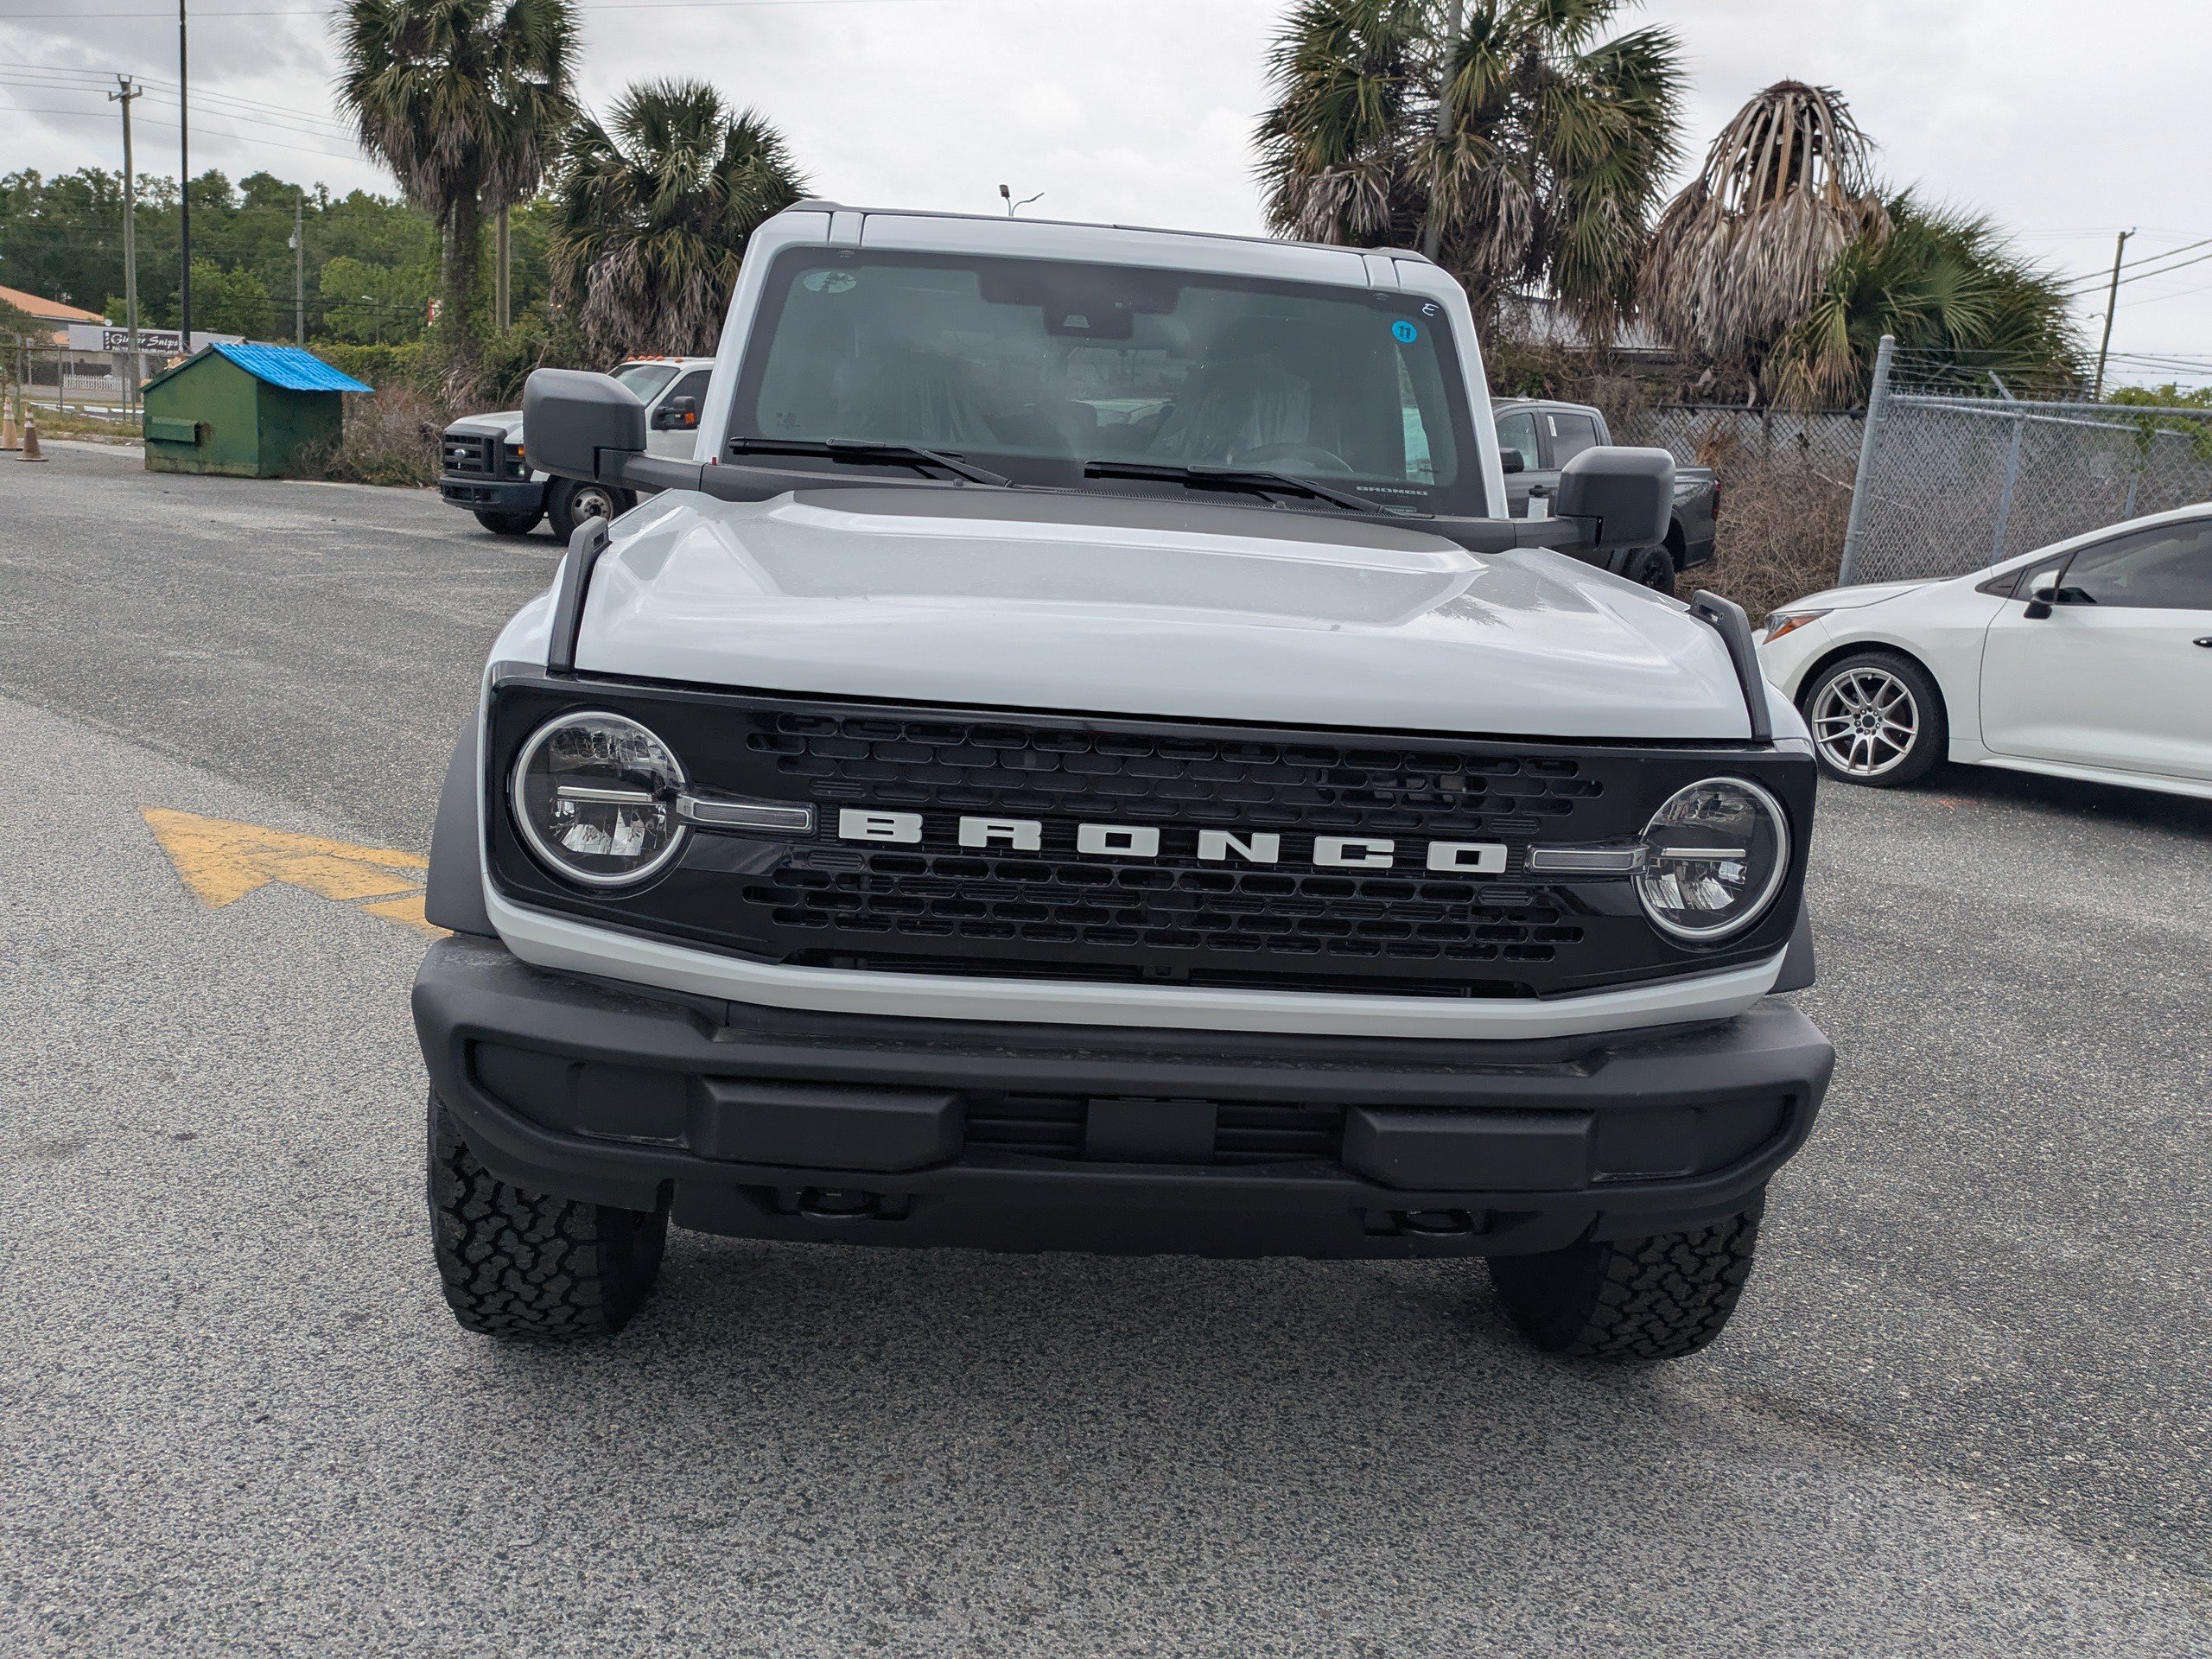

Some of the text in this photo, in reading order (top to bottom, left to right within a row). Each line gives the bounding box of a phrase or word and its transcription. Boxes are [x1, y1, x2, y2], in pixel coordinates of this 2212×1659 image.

[1397, 325, 1412, 340] 11
[111, 334, 179, 349] Gier Snips
[838, 807, 1509, 874] BRONCO
